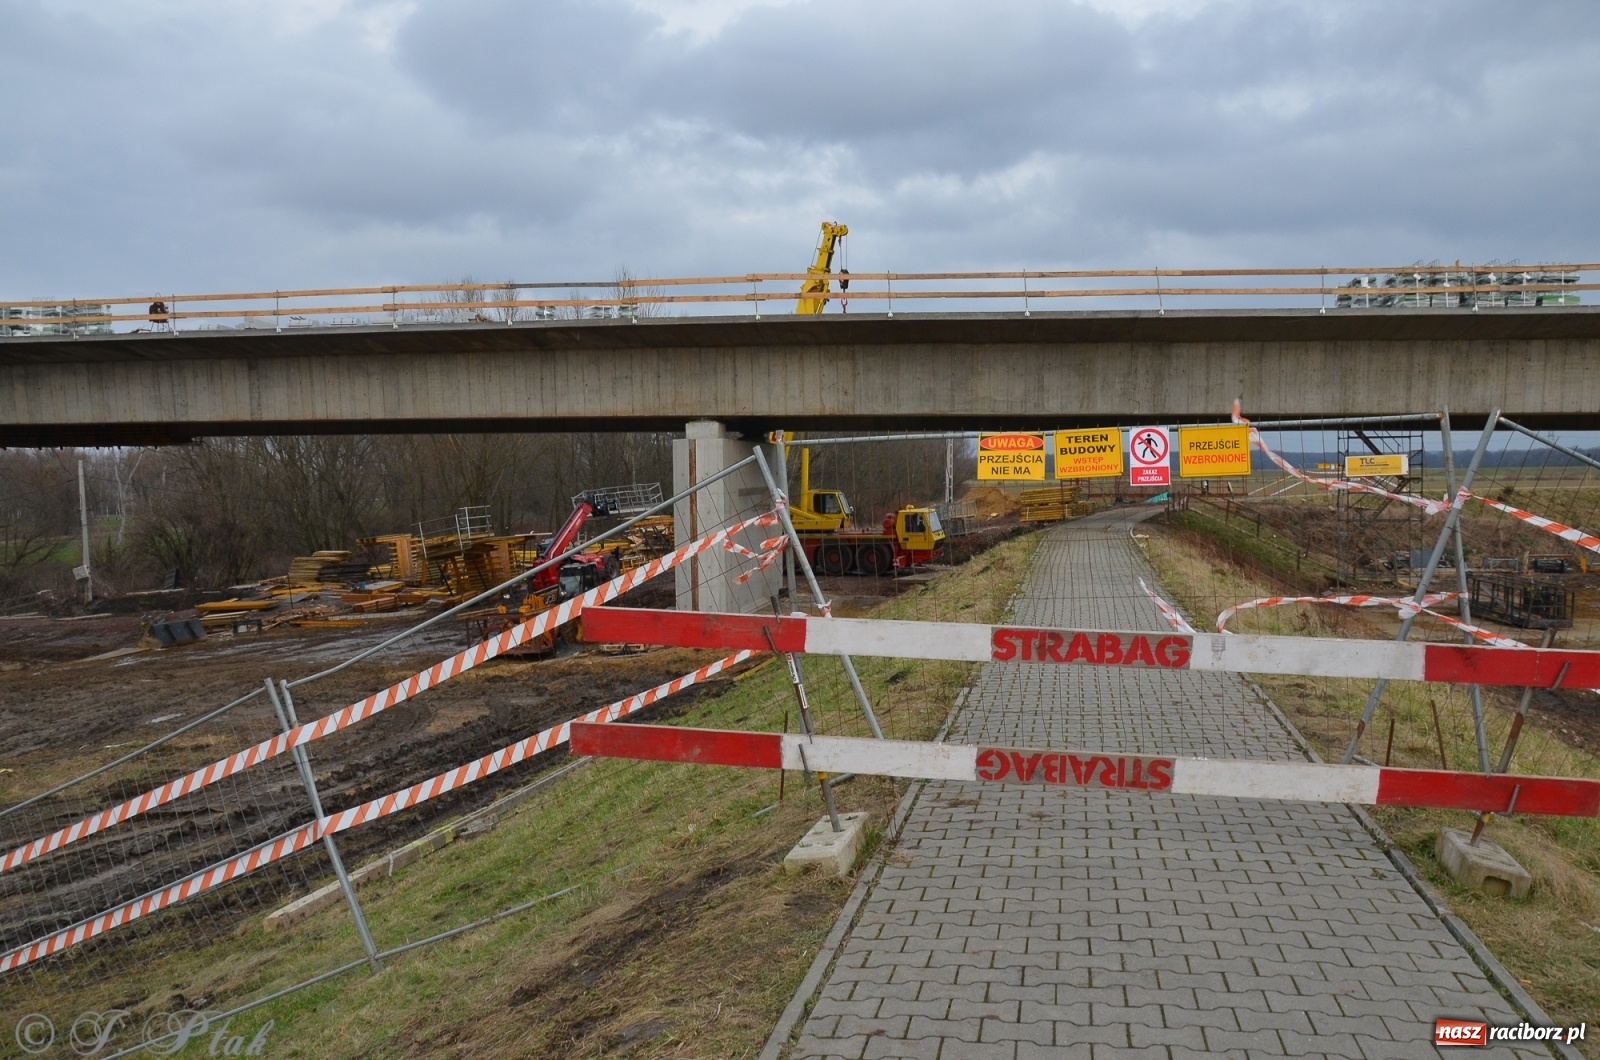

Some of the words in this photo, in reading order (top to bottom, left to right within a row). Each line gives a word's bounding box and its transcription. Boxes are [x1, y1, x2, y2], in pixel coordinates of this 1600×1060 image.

[988, 437, 1035, 449] UWAGA
[1066, 434, 1109, 444] TEREN
[1189, 438, 1240, 451] PRZEJŚCIE
[1060, 444, 1116, 456] BUDOWY
[979, 452, 1043, 464] PRZEJŚCIA
[1073, 456, 1104, 465] WSTĘP
[1183, 453, 1247, 465] WZBRONIONE
[991, 465, 1010, 476] NIE
[1013, 465, 1031, 476] MA
[1059, 463, 1119, 474] WZBRONIONY
[992, 628, 1192, 668] STRABAG
[975, 749, 1173, 791] STRABAG
